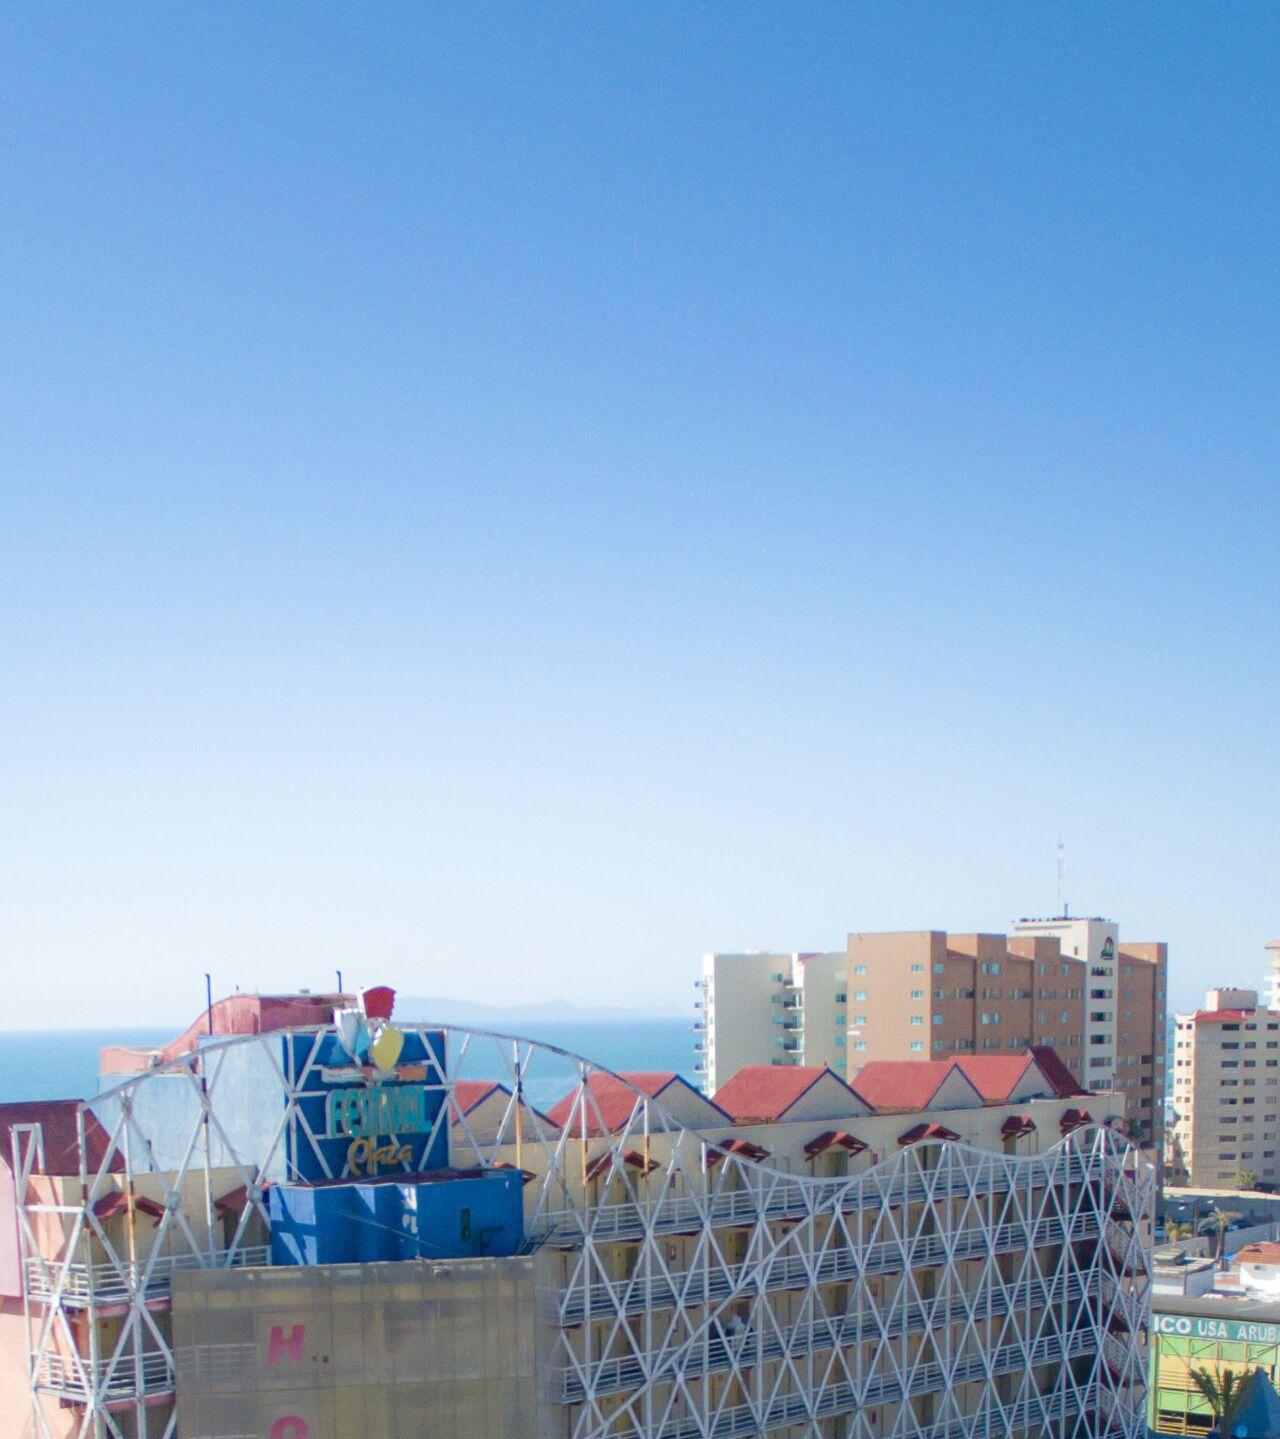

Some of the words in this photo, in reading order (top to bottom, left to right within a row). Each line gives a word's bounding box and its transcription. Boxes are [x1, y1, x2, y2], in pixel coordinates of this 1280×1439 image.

[325, 1086, 432, 1139] FESTIVAL
[347, 1138, 413, 1178] Plaza
[1197, 1321, 1228, 1339] USA
